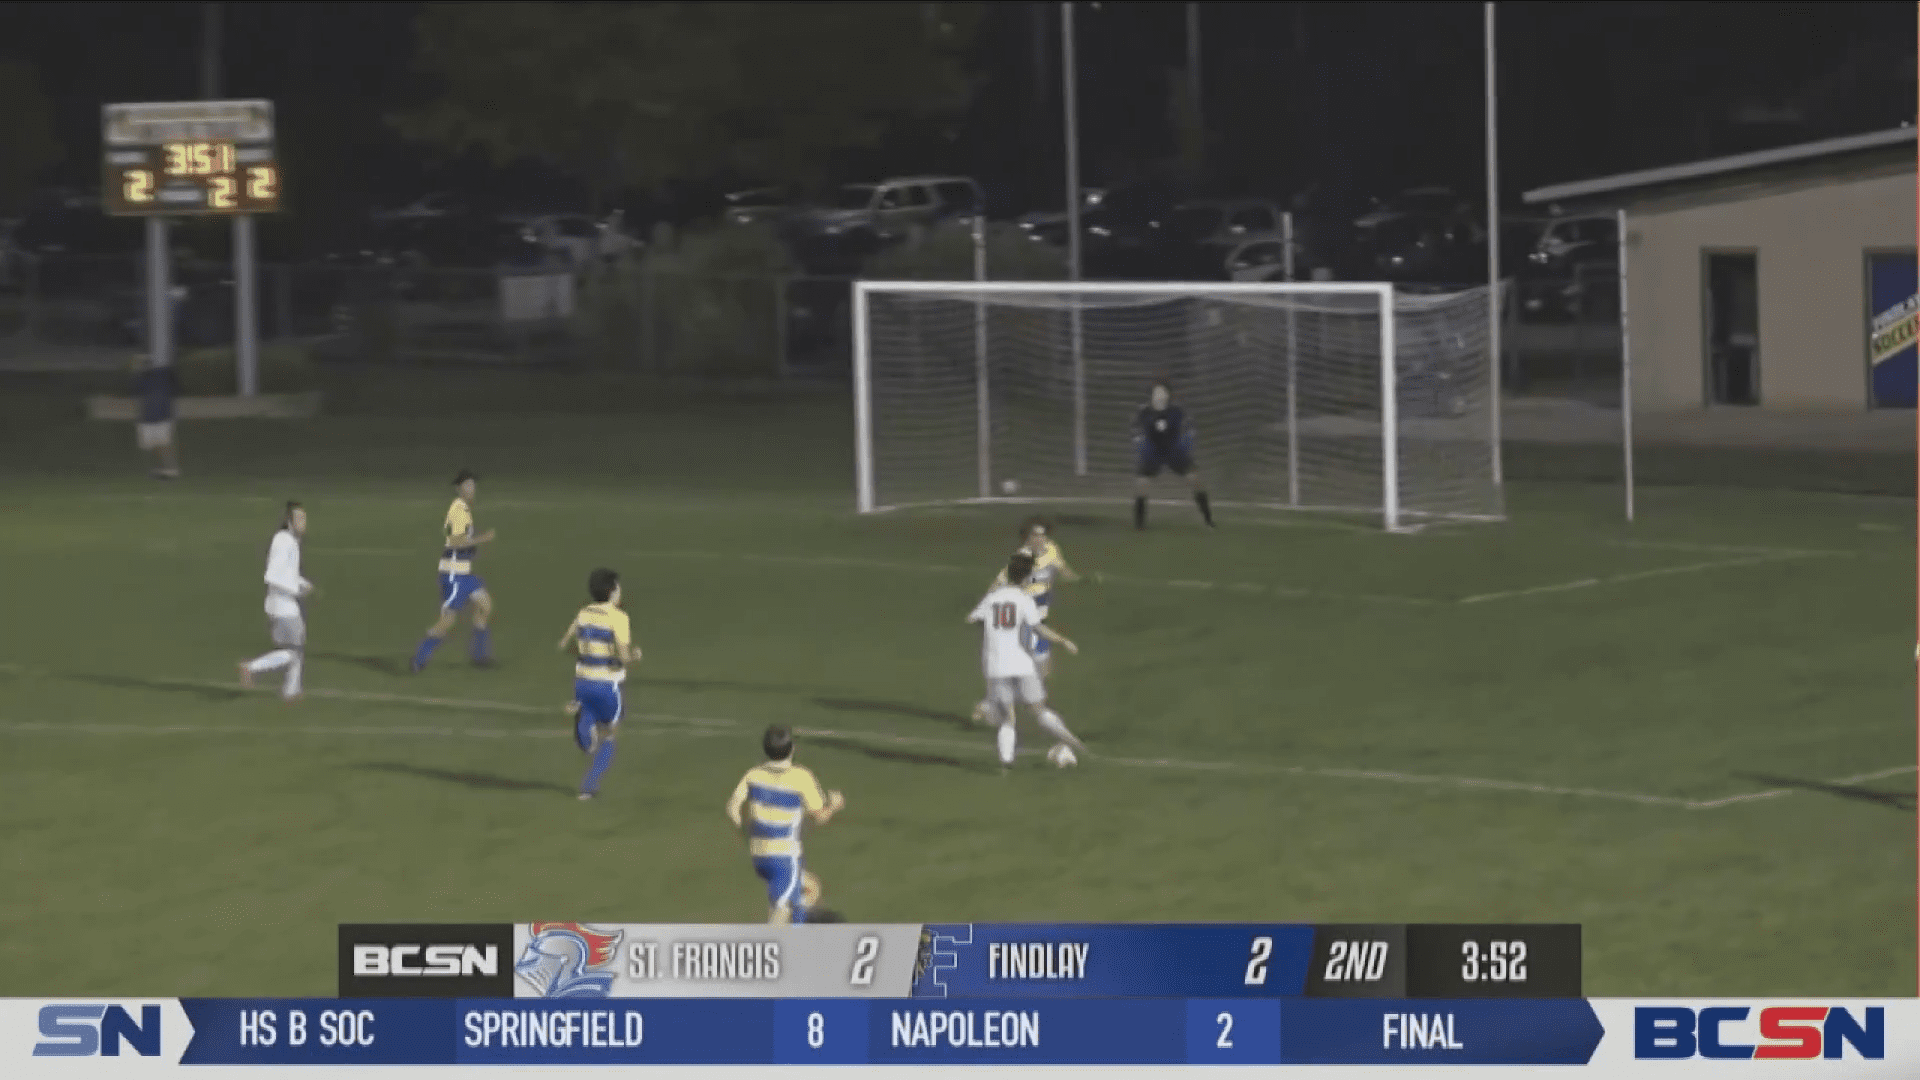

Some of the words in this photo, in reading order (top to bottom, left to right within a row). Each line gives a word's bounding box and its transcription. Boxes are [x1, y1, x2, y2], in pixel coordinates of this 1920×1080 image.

[122, 169, 155, 202] 2
[207, 176, 238, 208] 2
[246, 166, 277, 198] 2
[992, 601, 1016, 629] 10
